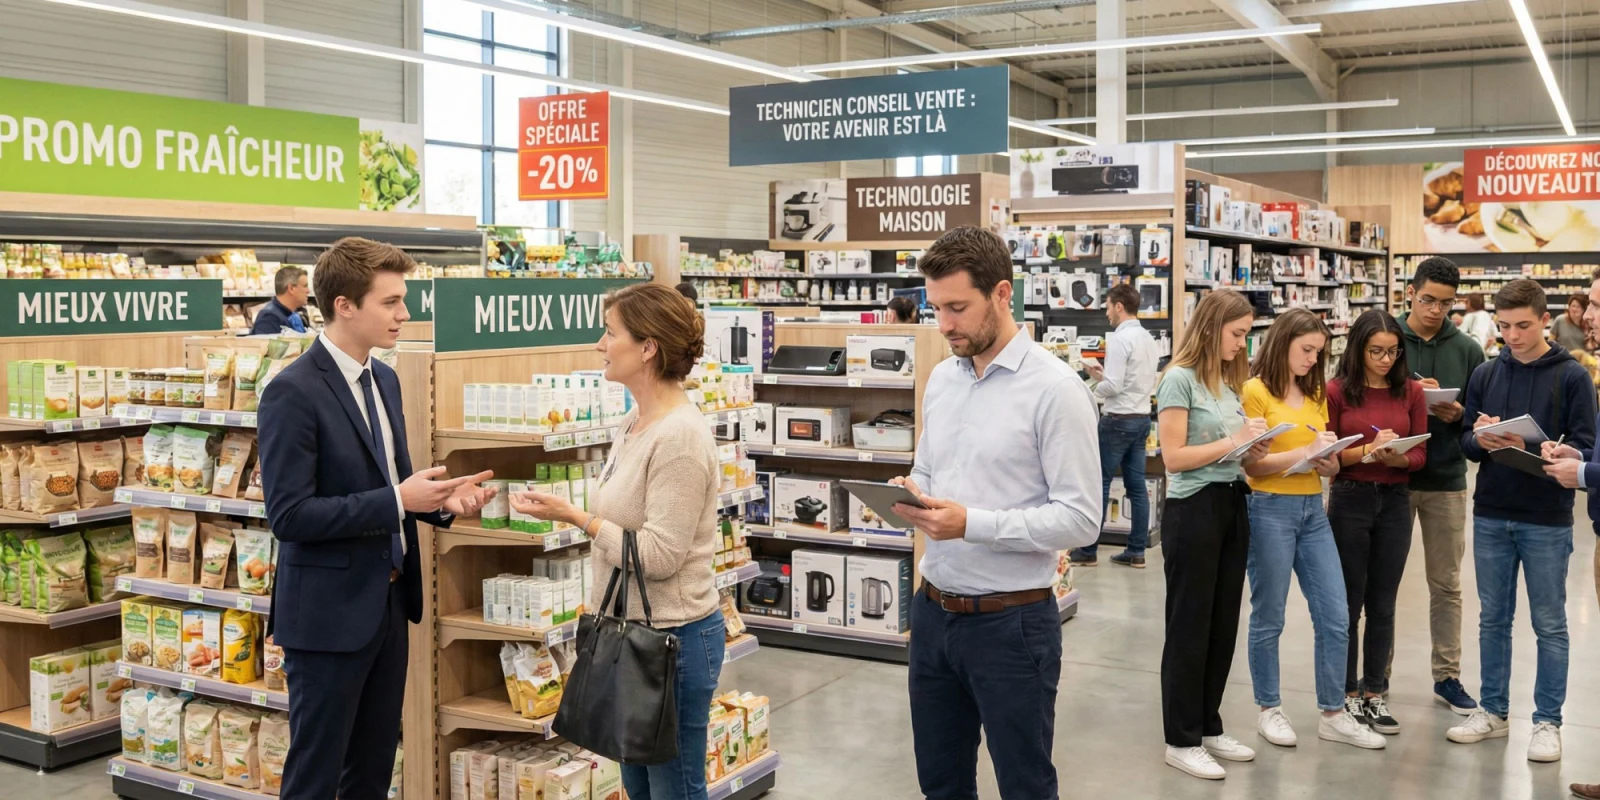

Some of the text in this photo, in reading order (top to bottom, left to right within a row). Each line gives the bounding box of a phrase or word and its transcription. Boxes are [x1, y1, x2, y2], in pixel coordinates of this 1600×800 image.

[538, 98, 587, 121] OFFRE
[756, 97, 842, 121] TECHNICIEN
[847, 93, 911, 116] CONSEIL
[915, 88, 966, 110] VENTE
[525, 121, 600, 146] SPÉCIALE
[782, 109, 947, 142] VOTRE AVENIR EST LÀ
[0, 114, 345, 183] PROMO FRAÎCHEUR
[1485, 151, 1578, 171] DÉCOUVREZ
[527, 154, 598, 190] -20%
[855, 184, 971, 208] TECHNOLOGIE
[879, 210, 946, 233] MAISON
[18, 291, 188, 324] MIEUX VIVRE
[474, 294, 554, 334] MIEUX
